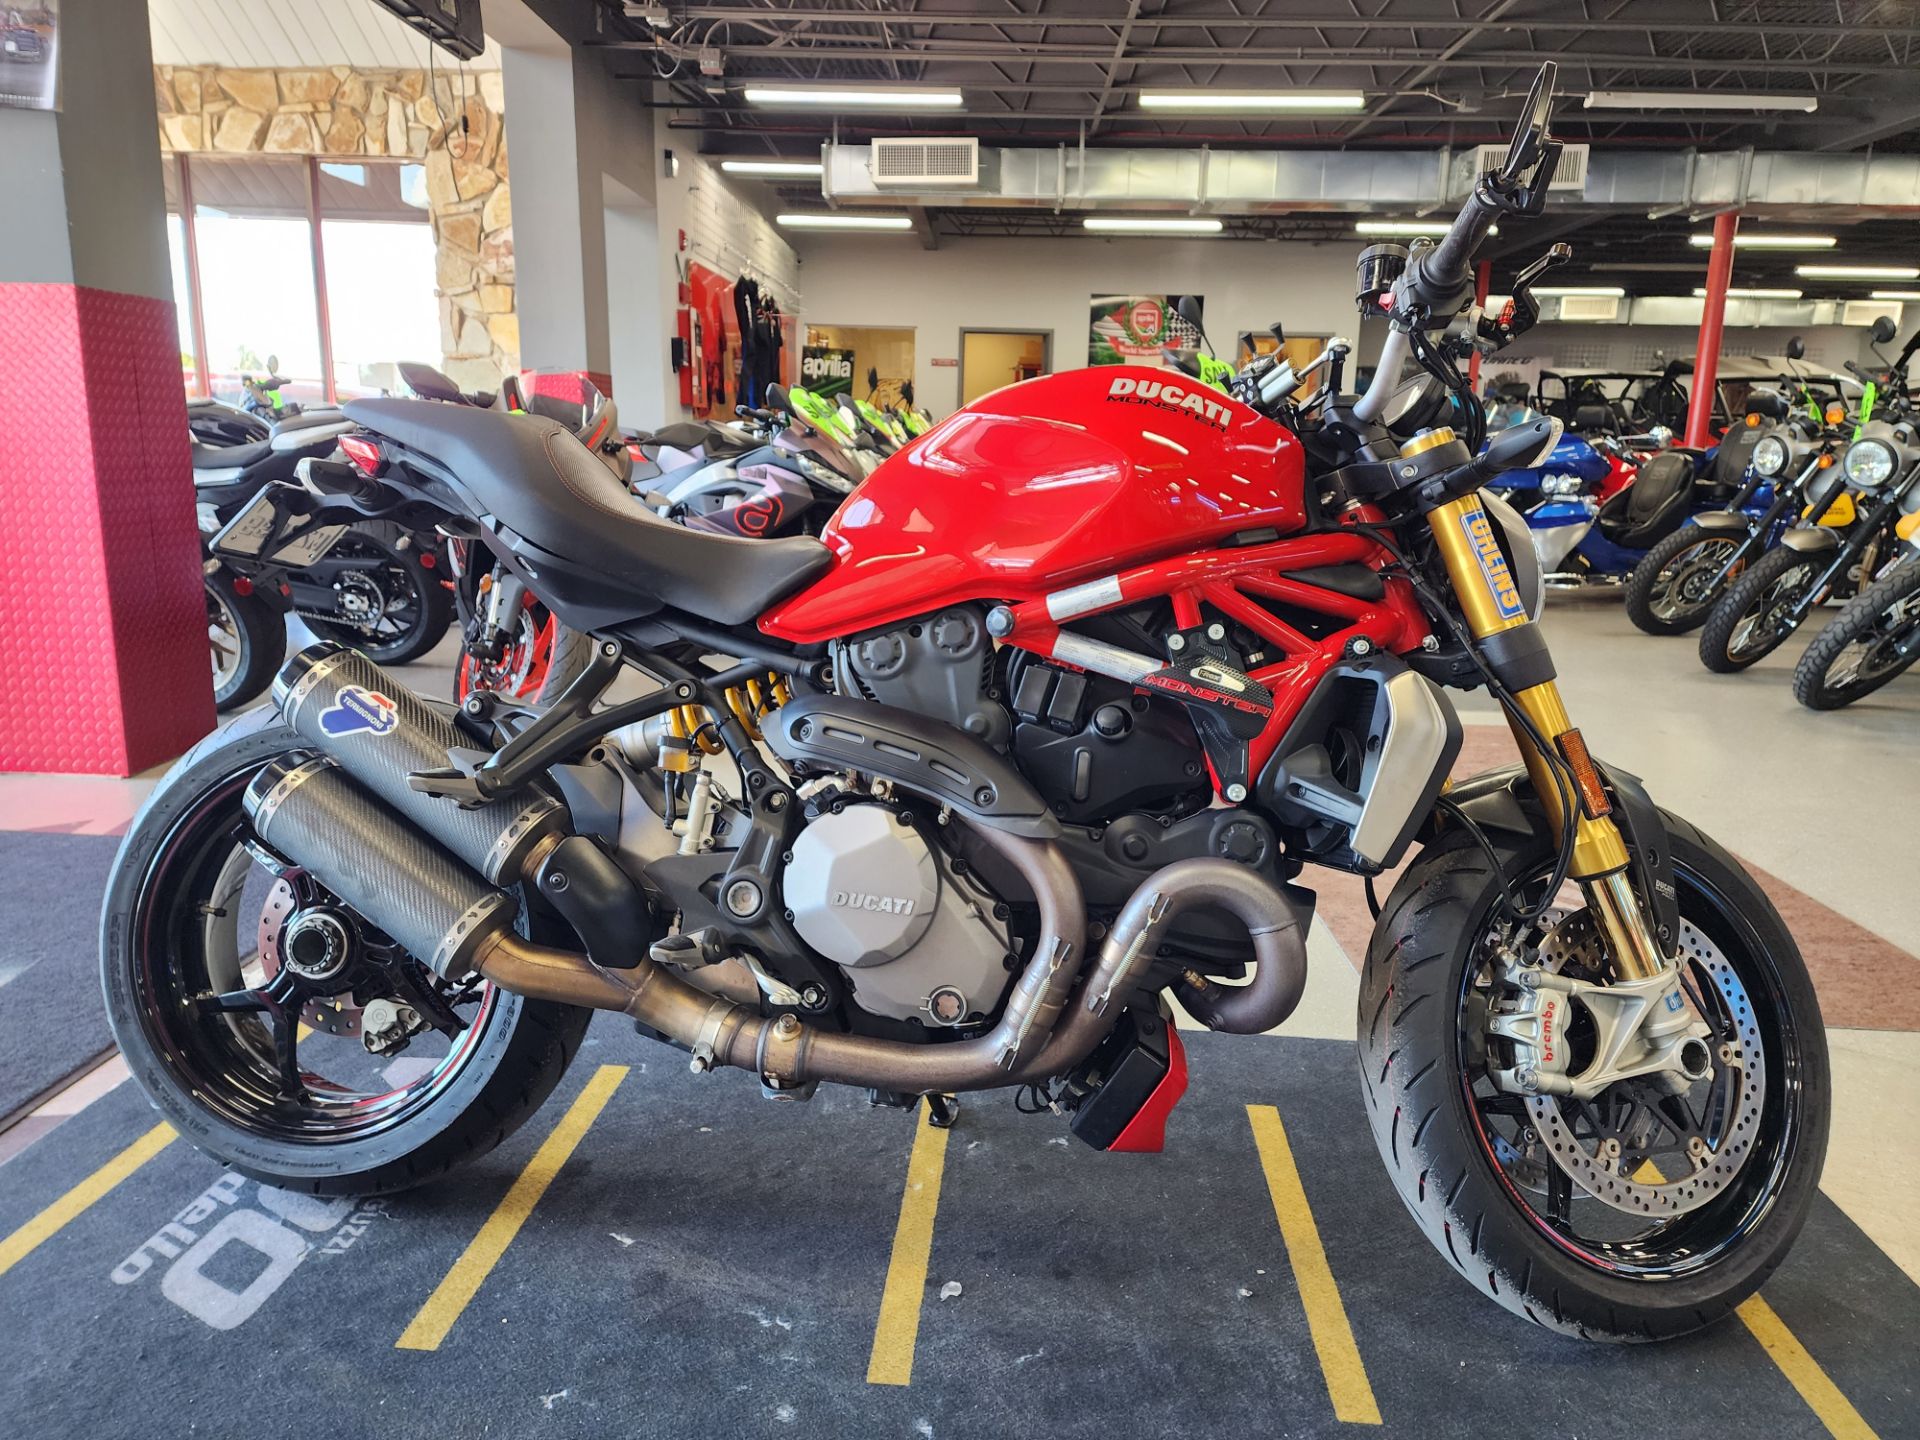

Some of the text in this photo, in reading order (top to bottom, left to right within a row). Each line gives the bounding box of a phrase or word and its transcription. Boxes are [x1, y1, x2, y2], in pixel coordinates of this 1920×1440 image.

[803, 354, 851, 380] aprilia
[1106, 395, 1227, 433] MONSTER
[1109, 377, 1233, 427] DUCATI
[343, 695, 385, 730] TERMIGNONI
[1143, 673, 1273, 718] MONSTER
[831, 890, 915, 916] DUCATI
[1541, 1001, 1556, 1063] brembo
